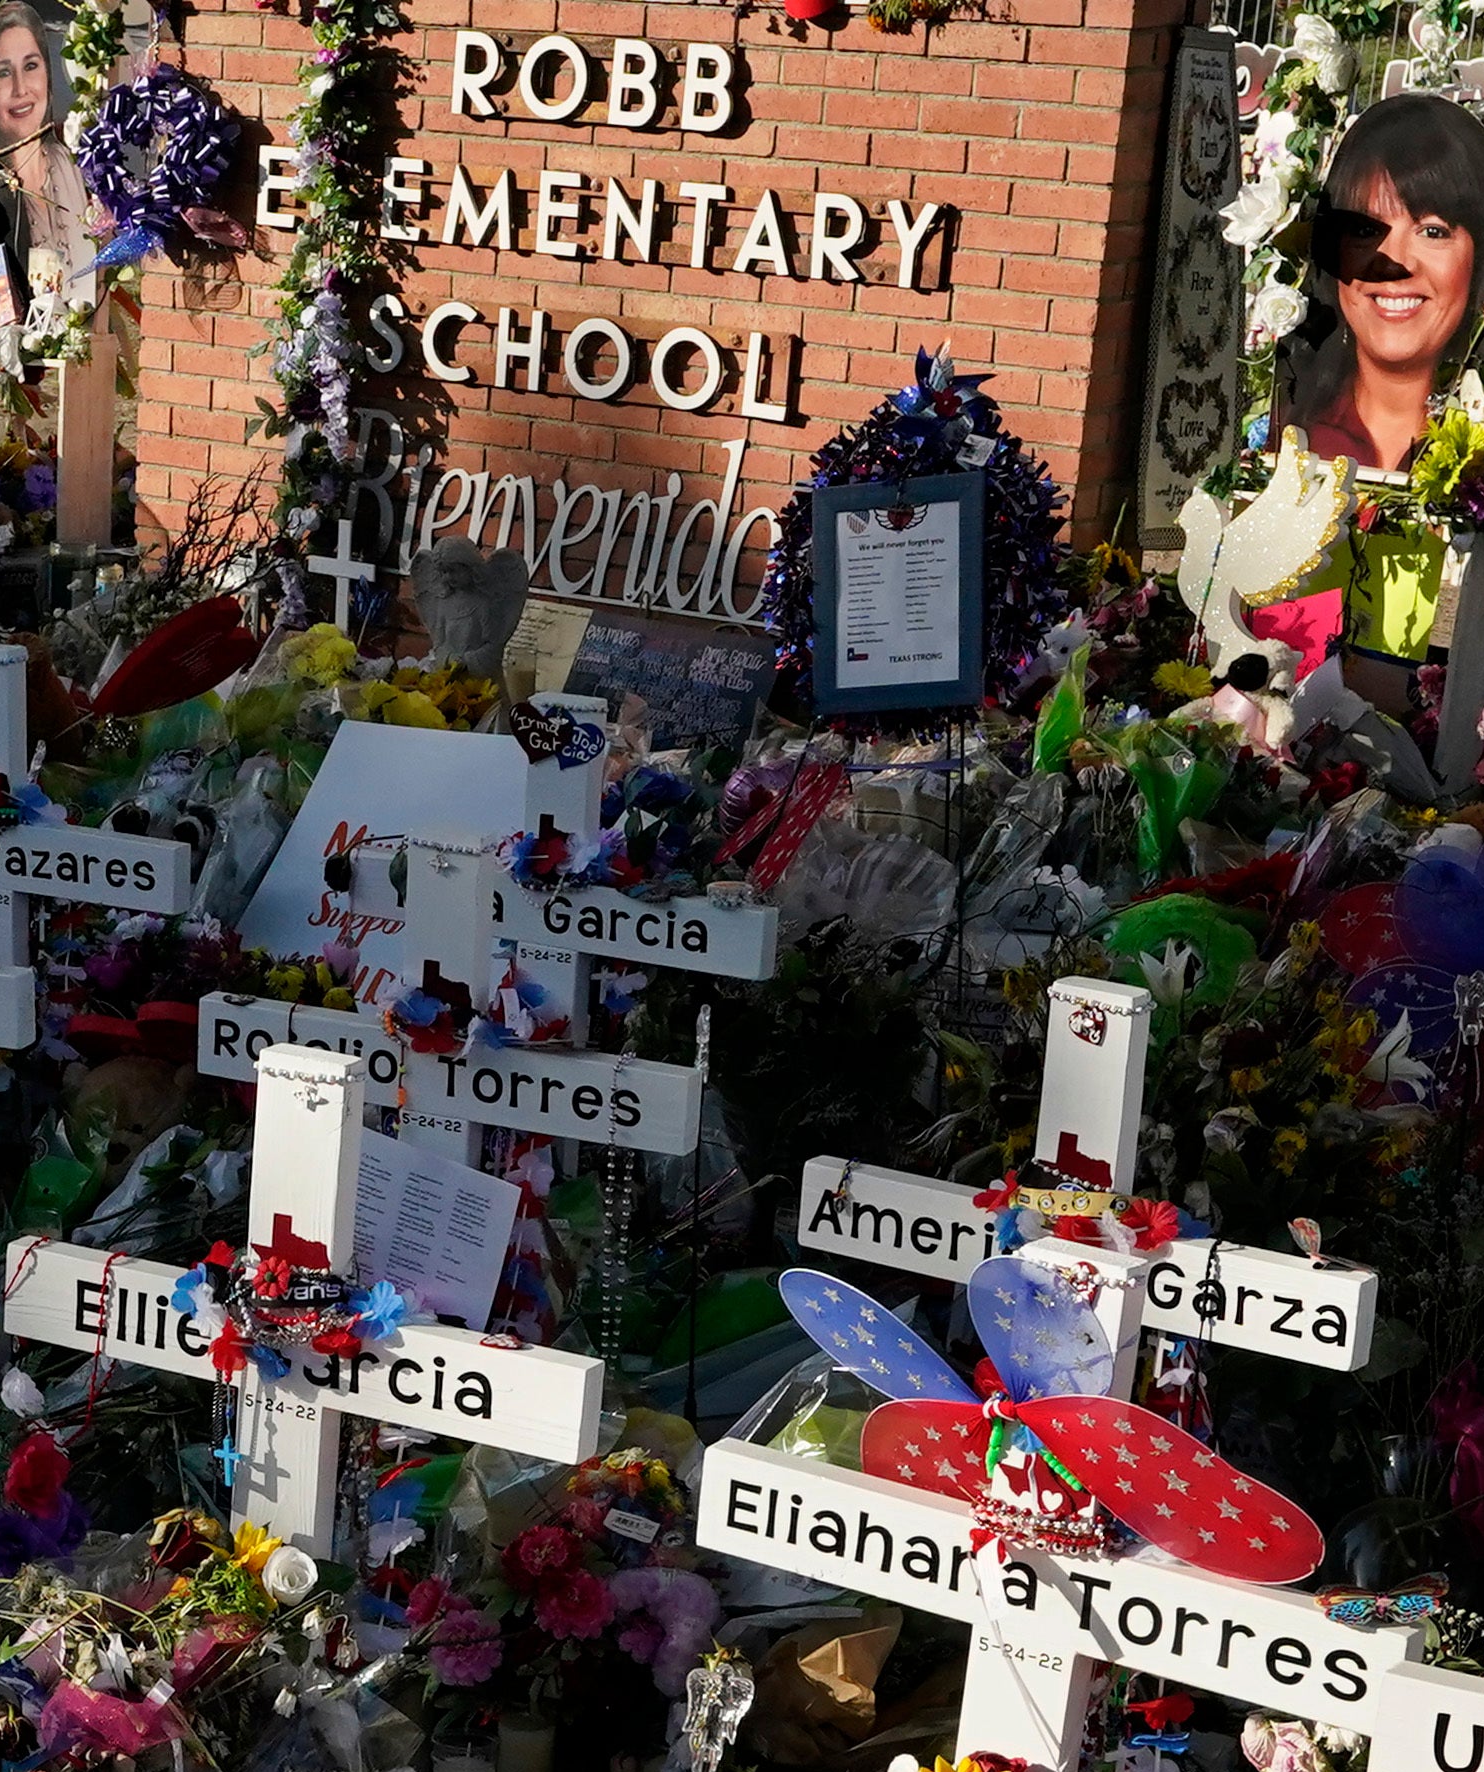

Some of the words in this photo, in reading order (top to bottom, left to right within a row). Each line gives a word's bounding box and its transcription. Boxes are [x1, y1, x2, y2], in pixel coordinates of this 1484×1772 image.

[450, 30, 735, 134] ROBB
[256, 143, 944, 289] EEMENTARY
[365, 292, 790, 424] SCHOOL
[1178, 415, 1205, 440] Love
[353, 405, 777, 627] Bienvenido
[858, 543, 871, 551] We
[872, 541, 885, 550] will
[886, 540, 906, 549] never
[907, 538, 930, 548] forget
[931, 537, 945, 547] you
[889, 654, 911, 663] TEXAS
[912, 652, 943, 662] STRONG
[516, 715, 560, 736] Irma
[308, 890, 407, 948] Suppo
[542, 893, 710, 955] Garcia
[519, 945, 573, 965] 5-24-22
[438, 1057, 641, 1128] Torres
[402, 1113, 463, 1133] 5-24-22
[809, 1190, 998, 1268] Ameri
[1147, 1263, 1350, 1349] Garza
[74, 1282, 210, 1361] Ellie
[292, 1358, 493, 1420] arcia
[245, 1394, 317, 1421] 5-24-22
[977, 1637, 1064, 1673] 5-24-22
[1068, 1573, 1369, 1700] Torres
